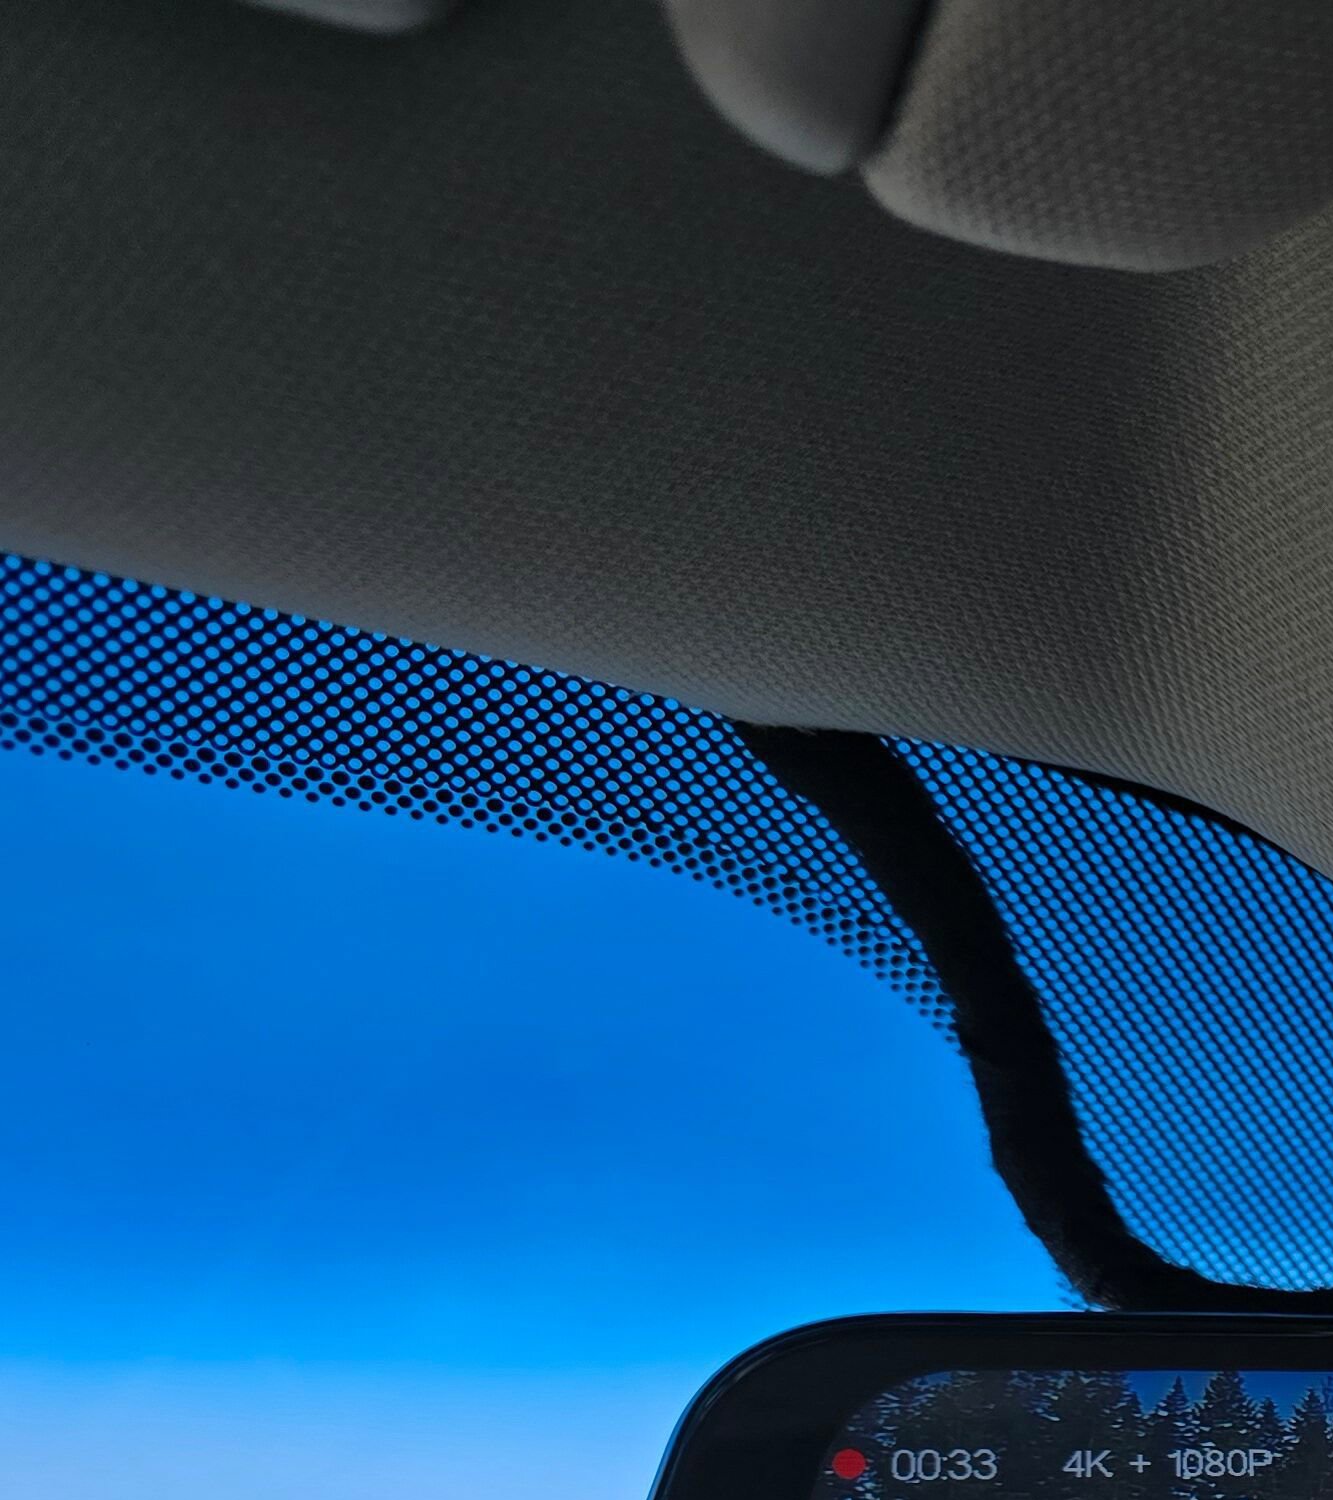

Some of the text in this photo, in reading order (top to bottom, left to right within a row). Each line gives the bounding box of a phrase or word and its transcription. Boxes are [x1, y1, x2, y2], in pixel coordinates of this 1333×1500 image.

[891, 1448, 998, 1481] 00:33
[1063, 1449, 1112, 1479] 4K
[1170, 1448, 1274, 1479] 1080P
